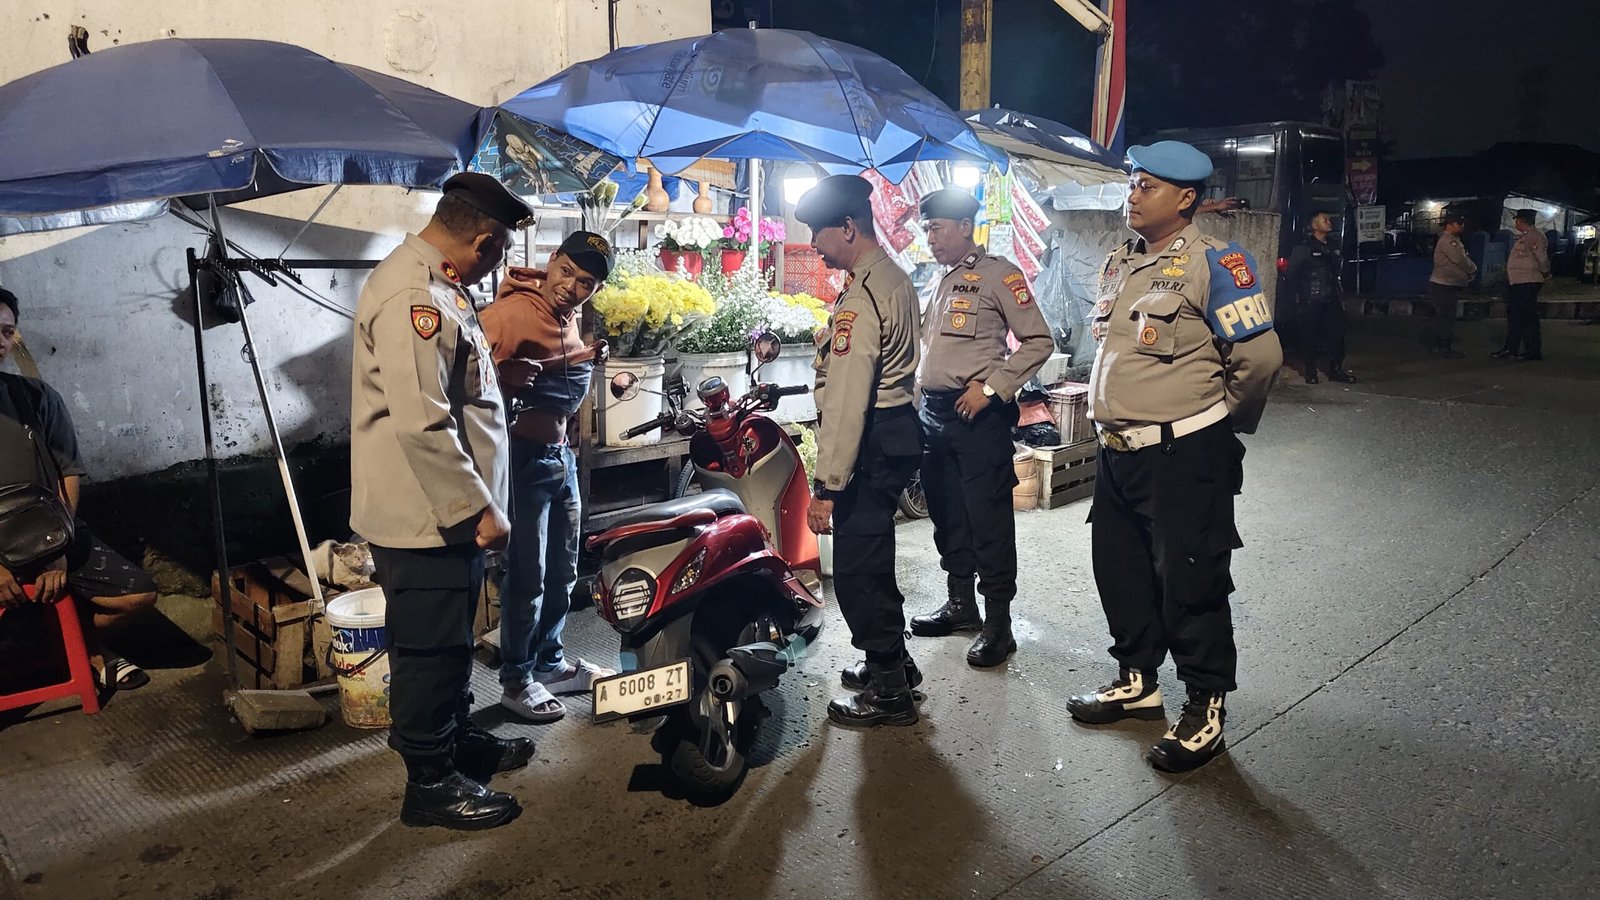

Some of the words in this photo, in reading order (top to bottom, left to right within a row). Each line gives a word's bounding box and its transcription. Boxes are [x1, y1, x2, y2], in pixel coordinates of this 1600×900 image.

[952, 284, 980, 294] POLRI
[1150, 280, 1185, 292] POLRI
[599, 685, 608, 702] A
[619, 673, 655, 697] 6008
[666, 667, 683, 686] ZT
